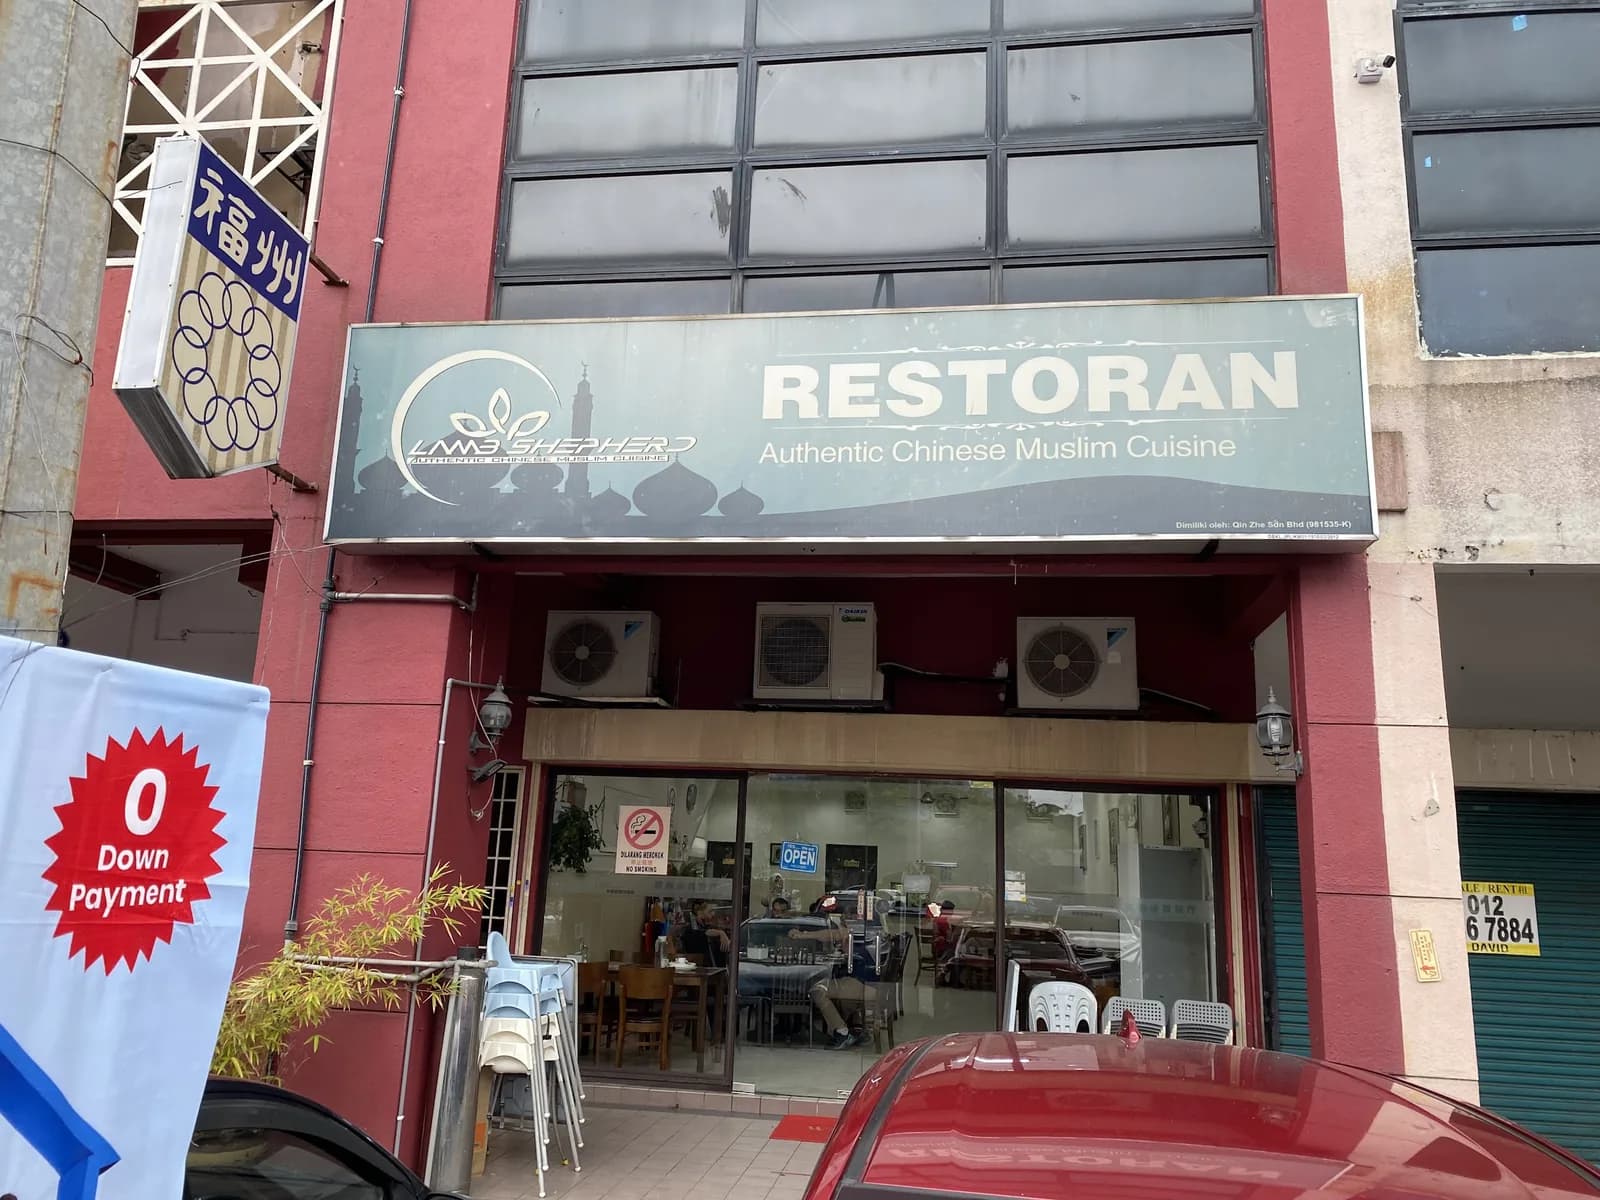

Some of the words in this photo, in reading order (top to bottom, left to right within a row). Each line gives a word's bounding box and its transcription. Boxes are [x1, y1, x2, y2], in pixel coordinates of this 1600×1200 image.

[193, 167, 301, 305] 福州
[762, 351, 1299, 419] RESTORAN
[407, 439, 501, 456] LAMB
[506, 436, 698, 455] SHEPHERD
[759, 442, 884, 465] Authentic
[892, 439, 1007, 463] Chinese
[1015, 434, 1117, 460] Muslim
[1126, 434, 1237, 458] Cuisine
[1175, 521, 1207, 529] Dimiliki
[1232, 521, 1248, 529] Qin
[1249, 521, 1266, 529] Zhe
[1267, 520, 1285, 529] Sdn
[124, 768, 167, 836] 0
[97, 844, 169, 871] Down
[784, 848, 816, 867] OPEN
[69, 879, 187, 918] Payment
[1488, 883, 1515, 895] RENT
[1467, 894, 1504, 916] 012
[1466, 916, 1479, 941] 6
[1484, 916, 1534, 943] 7884
[1471, 942, 1509, 953] DAVID
